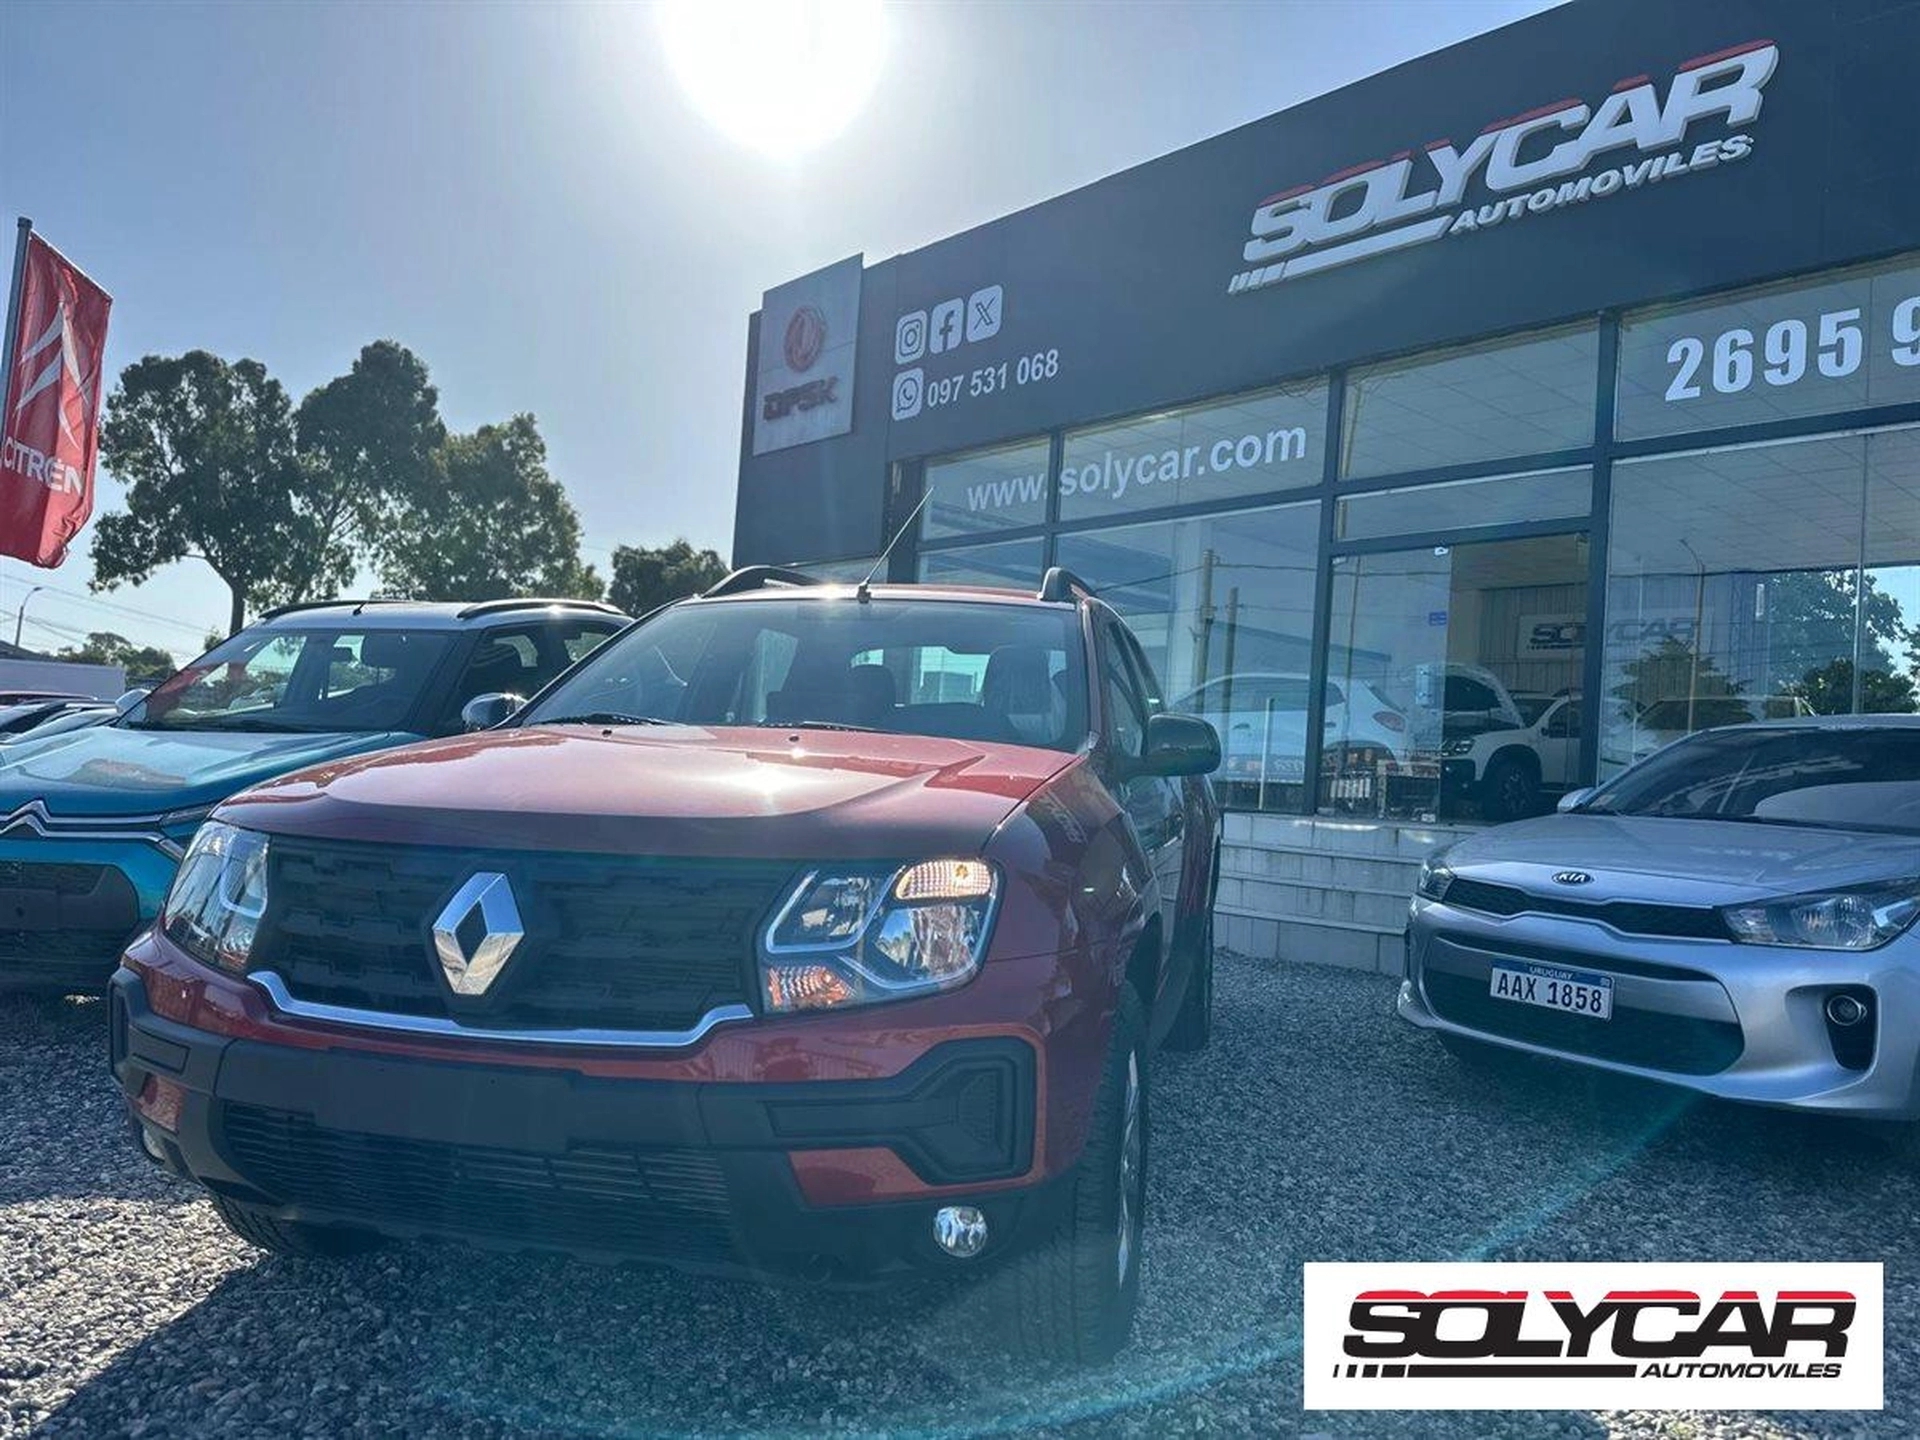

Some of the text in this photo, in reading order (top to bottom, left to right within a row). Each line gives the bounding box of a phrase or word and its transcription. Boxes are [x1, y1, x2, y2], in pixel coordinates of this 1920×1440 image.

[1242, 39, 1779, 264] SOLYCAR
[1448, 133, 1754, 236] AUTOMOVILES
[927, 349, 1059, 407] 097 531 068
[1665, 307, 1863, 402] 2695
[1558, 872, 1587, 883] KIA
[1497, 972, 1602, 1013] AAX 1858
[1529, 966, 1574, 981] URUGUAY
